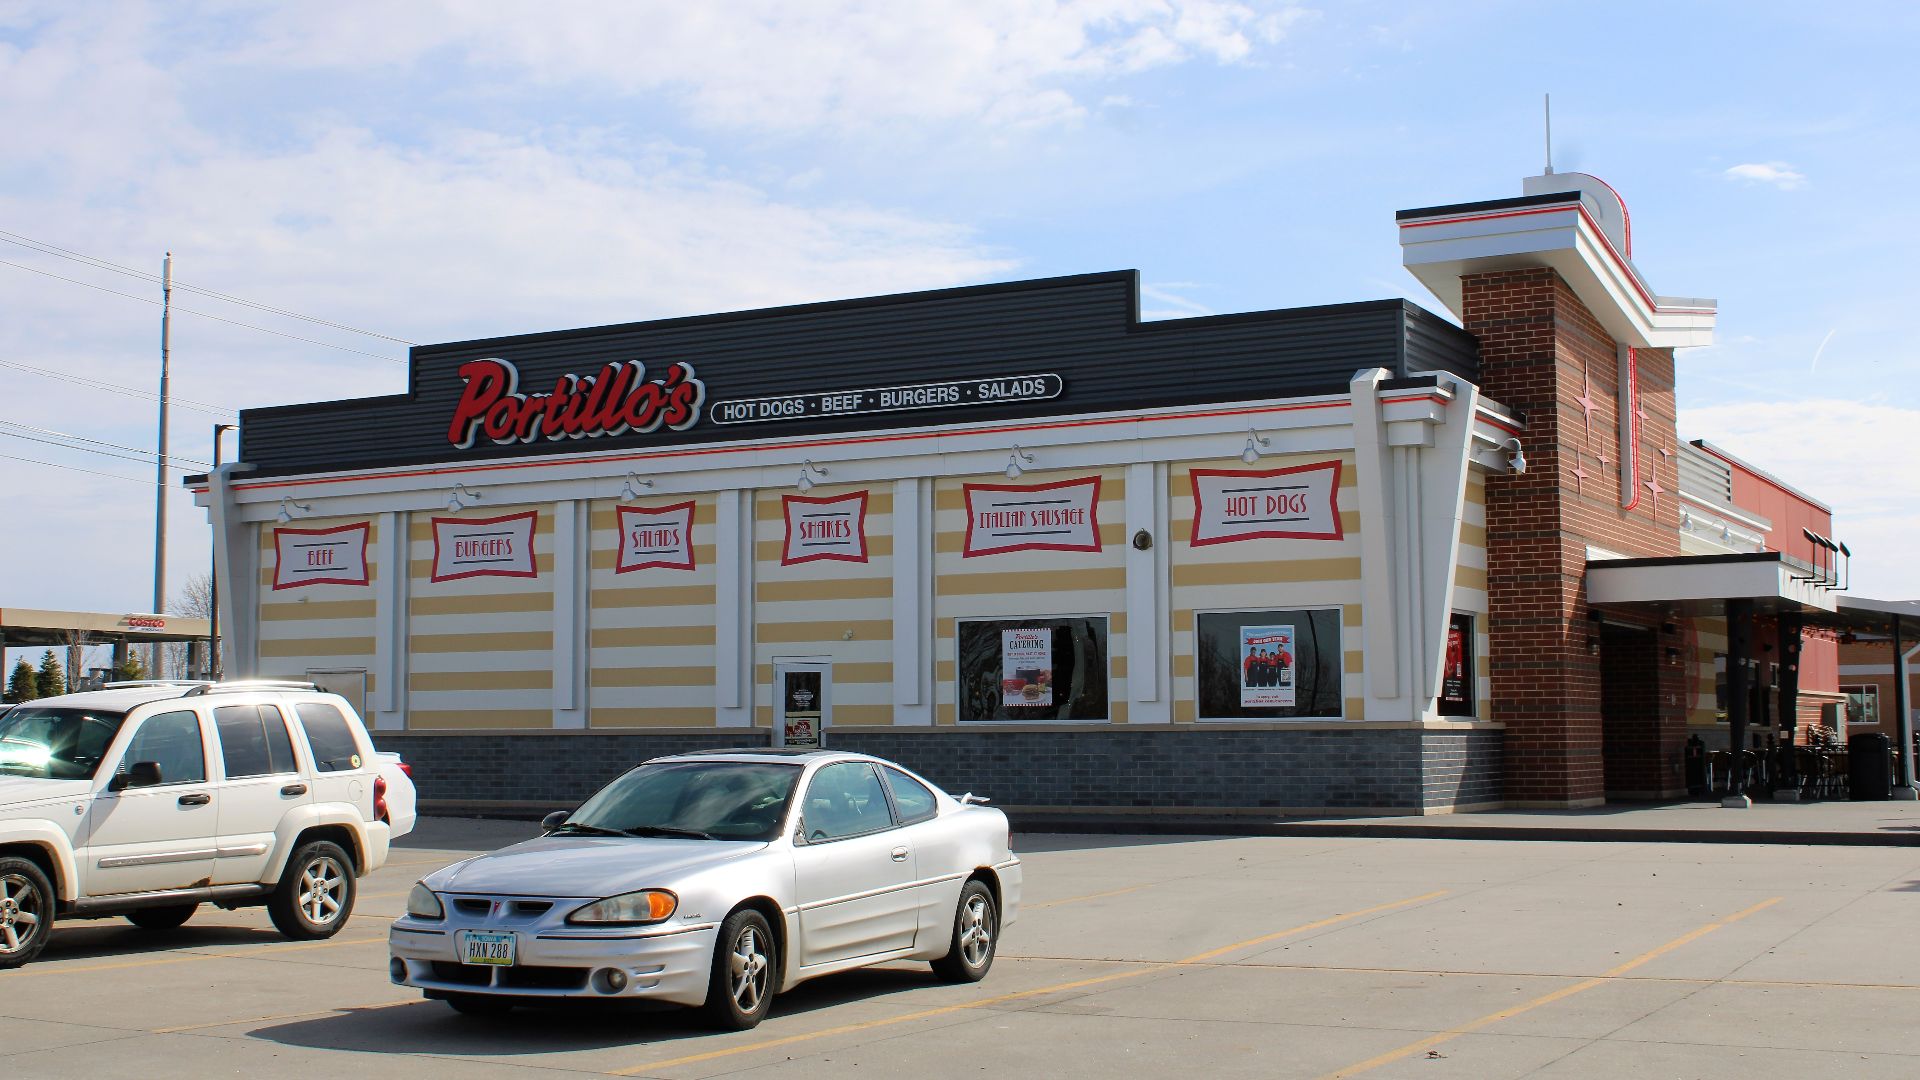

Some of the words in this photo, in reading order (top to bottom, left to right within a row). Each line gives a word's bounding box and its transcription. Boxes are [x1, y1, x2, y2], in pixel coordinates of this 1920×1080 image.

[448, 358, 703, 448] Portillo's
[724, 403, 756, 420] HOT
[760, 400, 805, 417] DOGS
[822, 394, 863, 412] BEEF
[880, 386, 960, 408] BURGERS
[978, 378, 1046, 400] SALADS
[1225, 495, 1258, 517] HOT
[1267, 493, 1307, 515] DOGS
[979, 509, 1027, 529] ITALIAN
[1031, 507, 1085, 527] SAUSAGE
[631, 528, 680, 549] SALADS
[799, 519, 851, 540] SHAKES
[307, 549, 335, 566] BEEF
[455, 538, 513, 559] BURGERS
[1009, 640, 1044, 649] CATERING
[469, 942, 488, 958] HXN
[491, 943, 509, 959] 288
